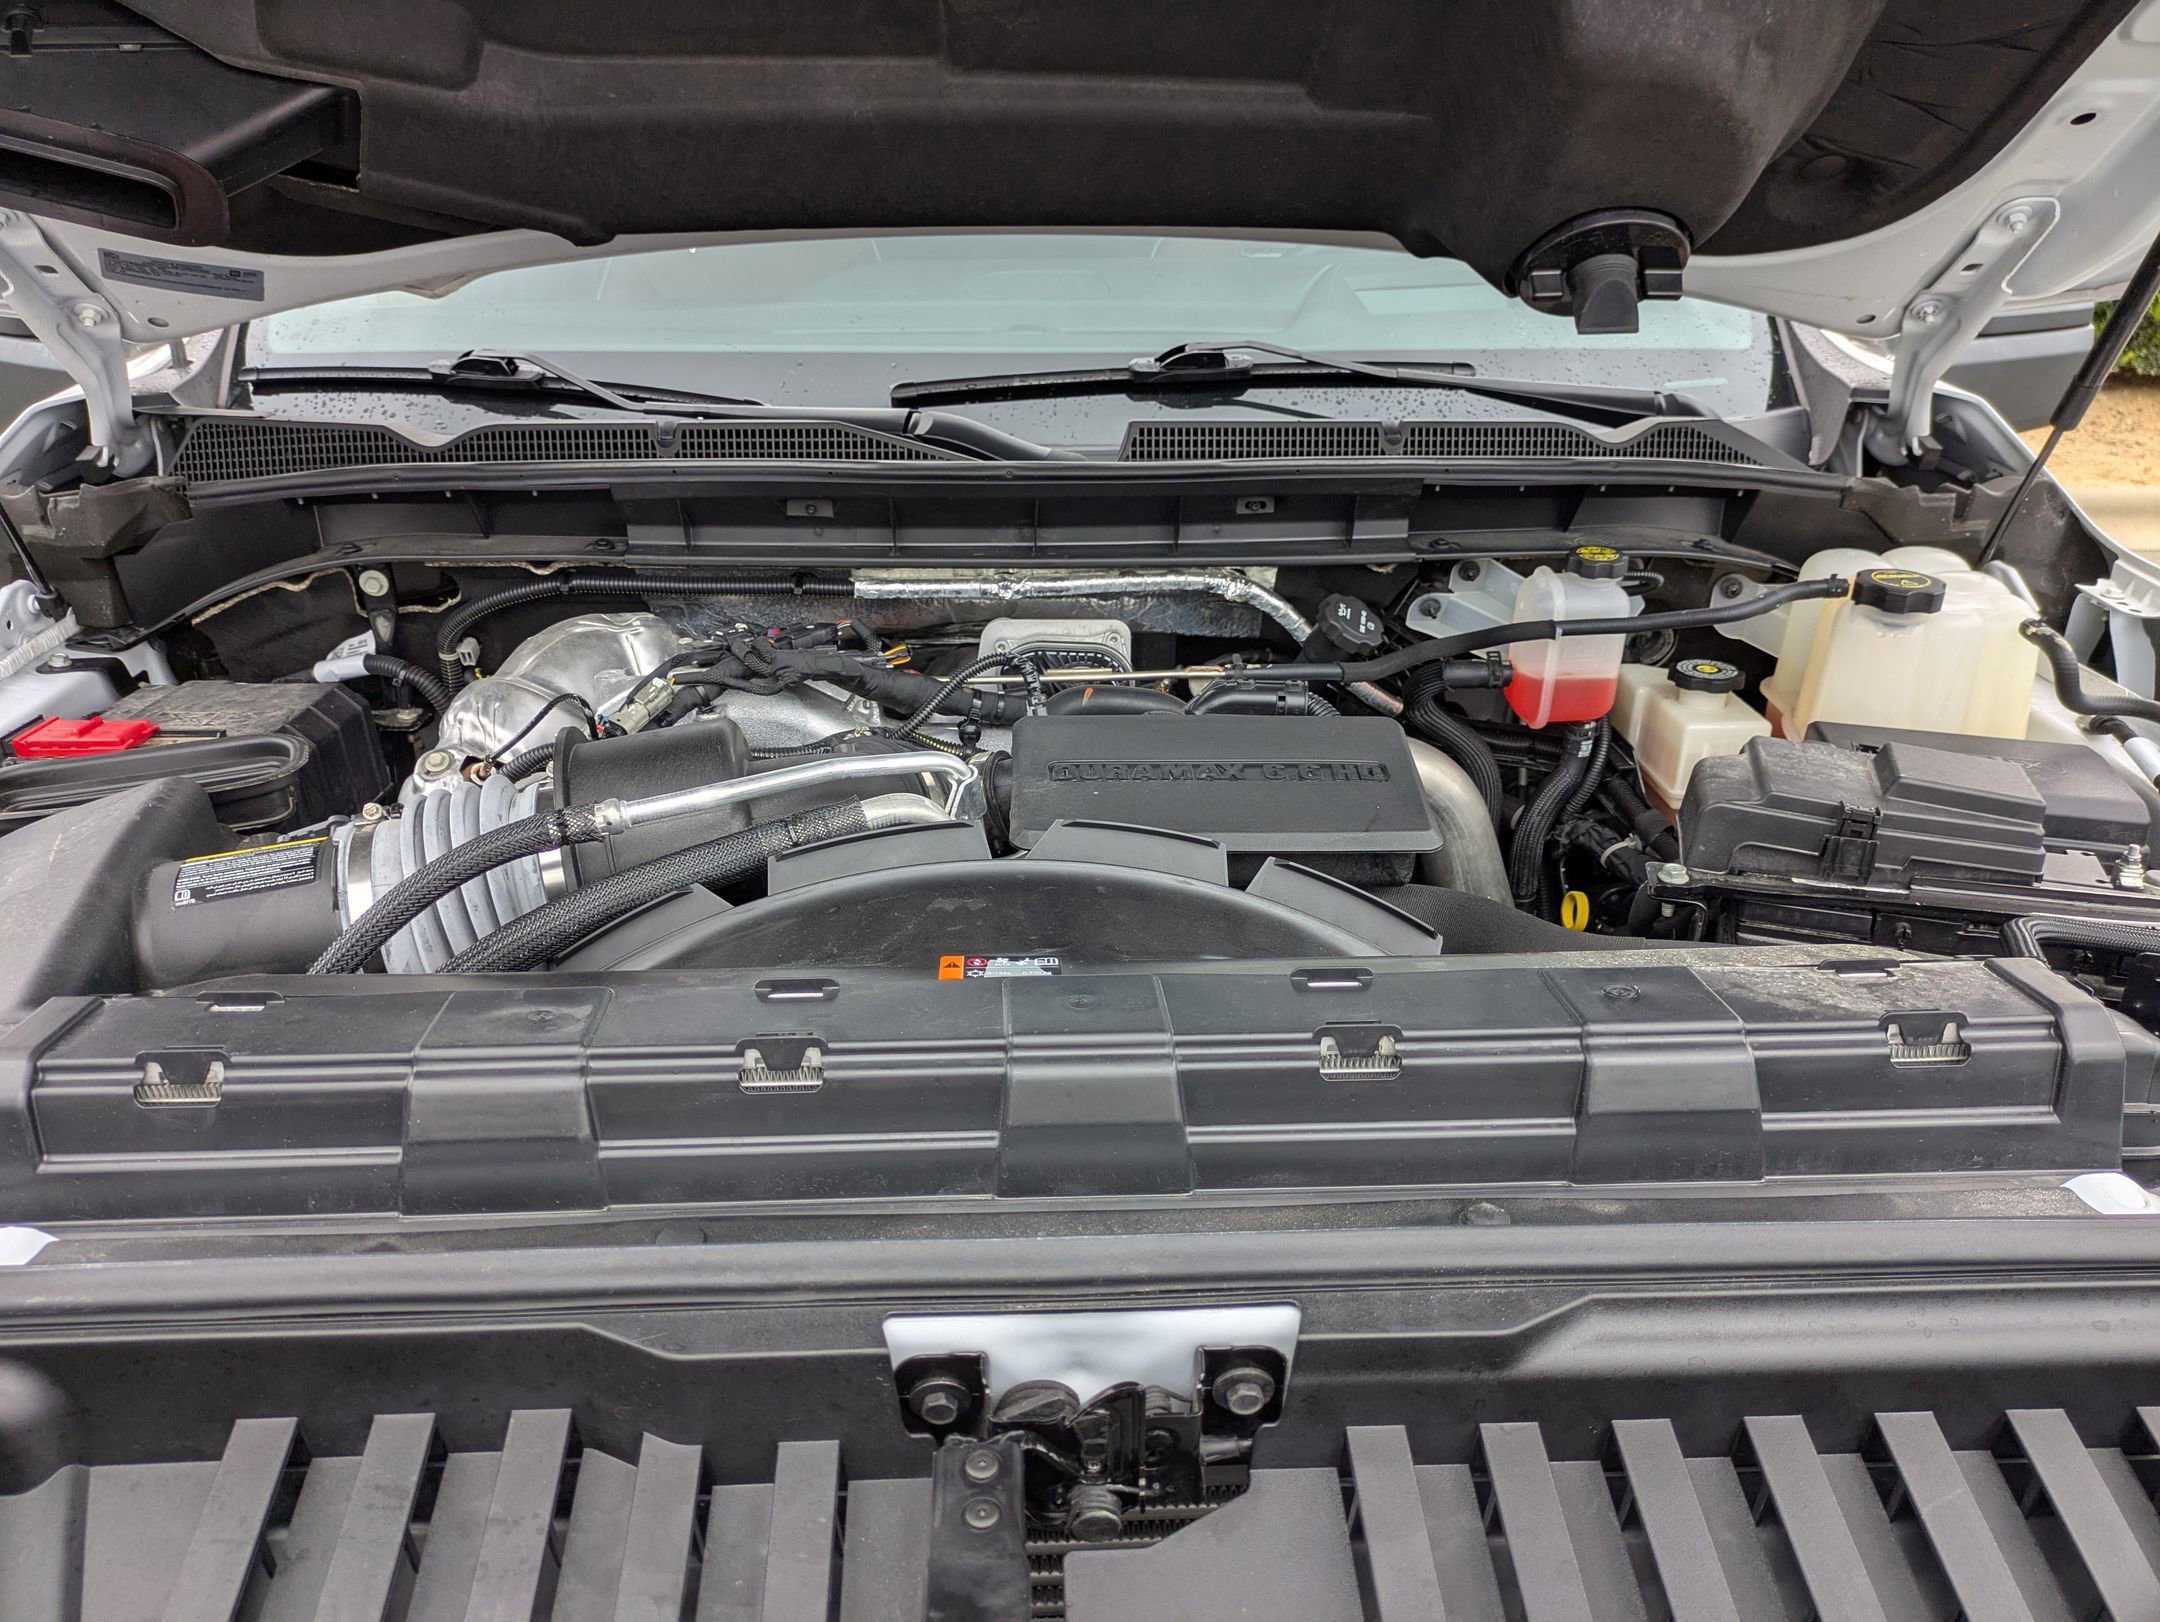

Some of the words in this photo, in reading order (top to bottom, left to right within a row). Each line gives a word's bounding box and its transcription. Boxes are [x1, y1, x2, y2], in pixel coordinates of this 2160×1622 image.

[1051, 763, 1246, 781] DURAMAX
[1262, 763, 1322, 781] 6.6
[1333, 763, 1386, 781] HD
